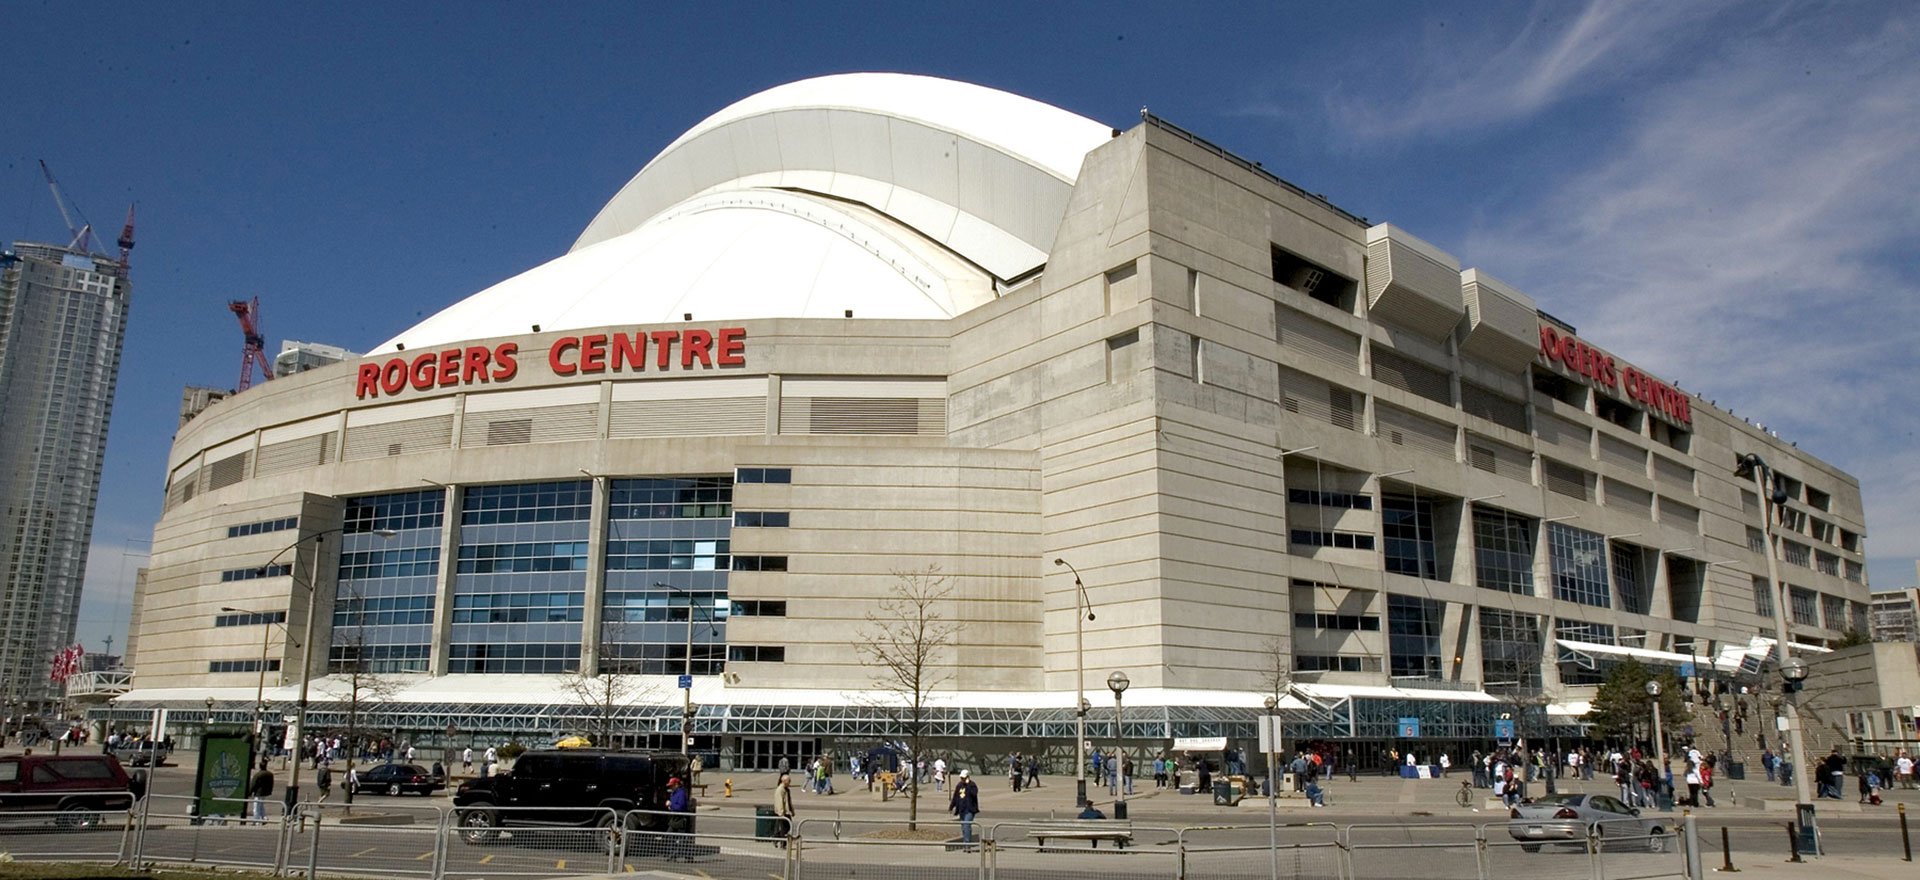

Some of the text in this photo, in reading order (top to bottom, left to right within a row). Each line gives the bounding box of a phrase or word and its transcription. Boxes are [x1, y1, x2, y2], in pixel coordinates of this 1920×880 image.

[356, 327, 747, 399] ROGERS CENTRE
[1539, 323, 1692, 425] OGERS CENTRE
